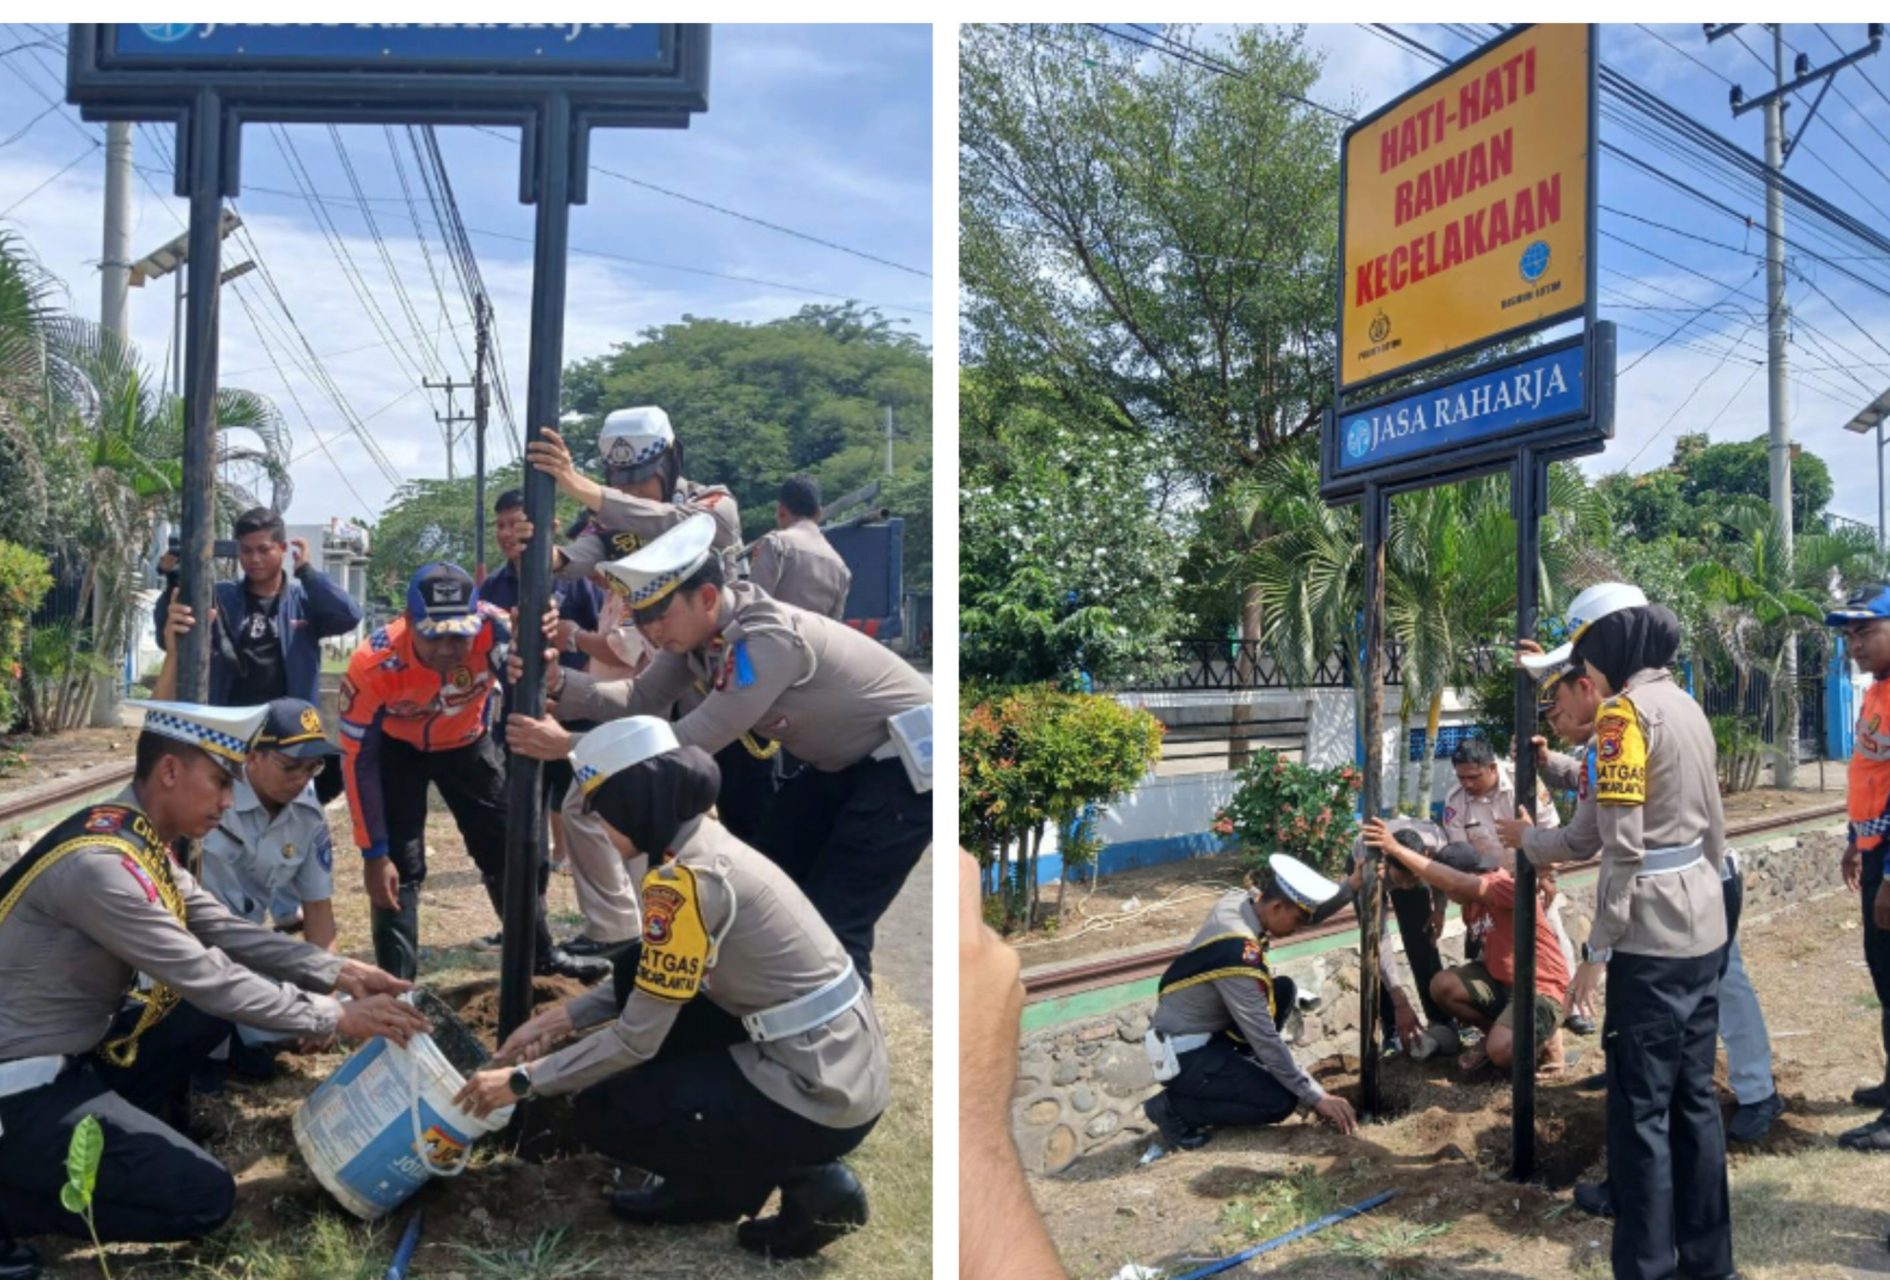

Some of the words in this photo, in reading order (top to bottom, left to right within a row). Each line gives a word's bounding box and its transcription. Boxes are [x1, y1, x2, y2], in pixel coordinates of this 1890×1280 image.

[1380, 46, 1537, 174] HATI-HATI
[1394, 127, 1514, 227] RAWAN
[1355, 172, 1562, 308] KECELAKAAN
[1370, 407, 1425, 451] JASA
[1433, 363, 1568, 429] RAHARJA
[1597, 765, 1646, 782] ATGAS
[640, 948, 699, 975] ATGAS
